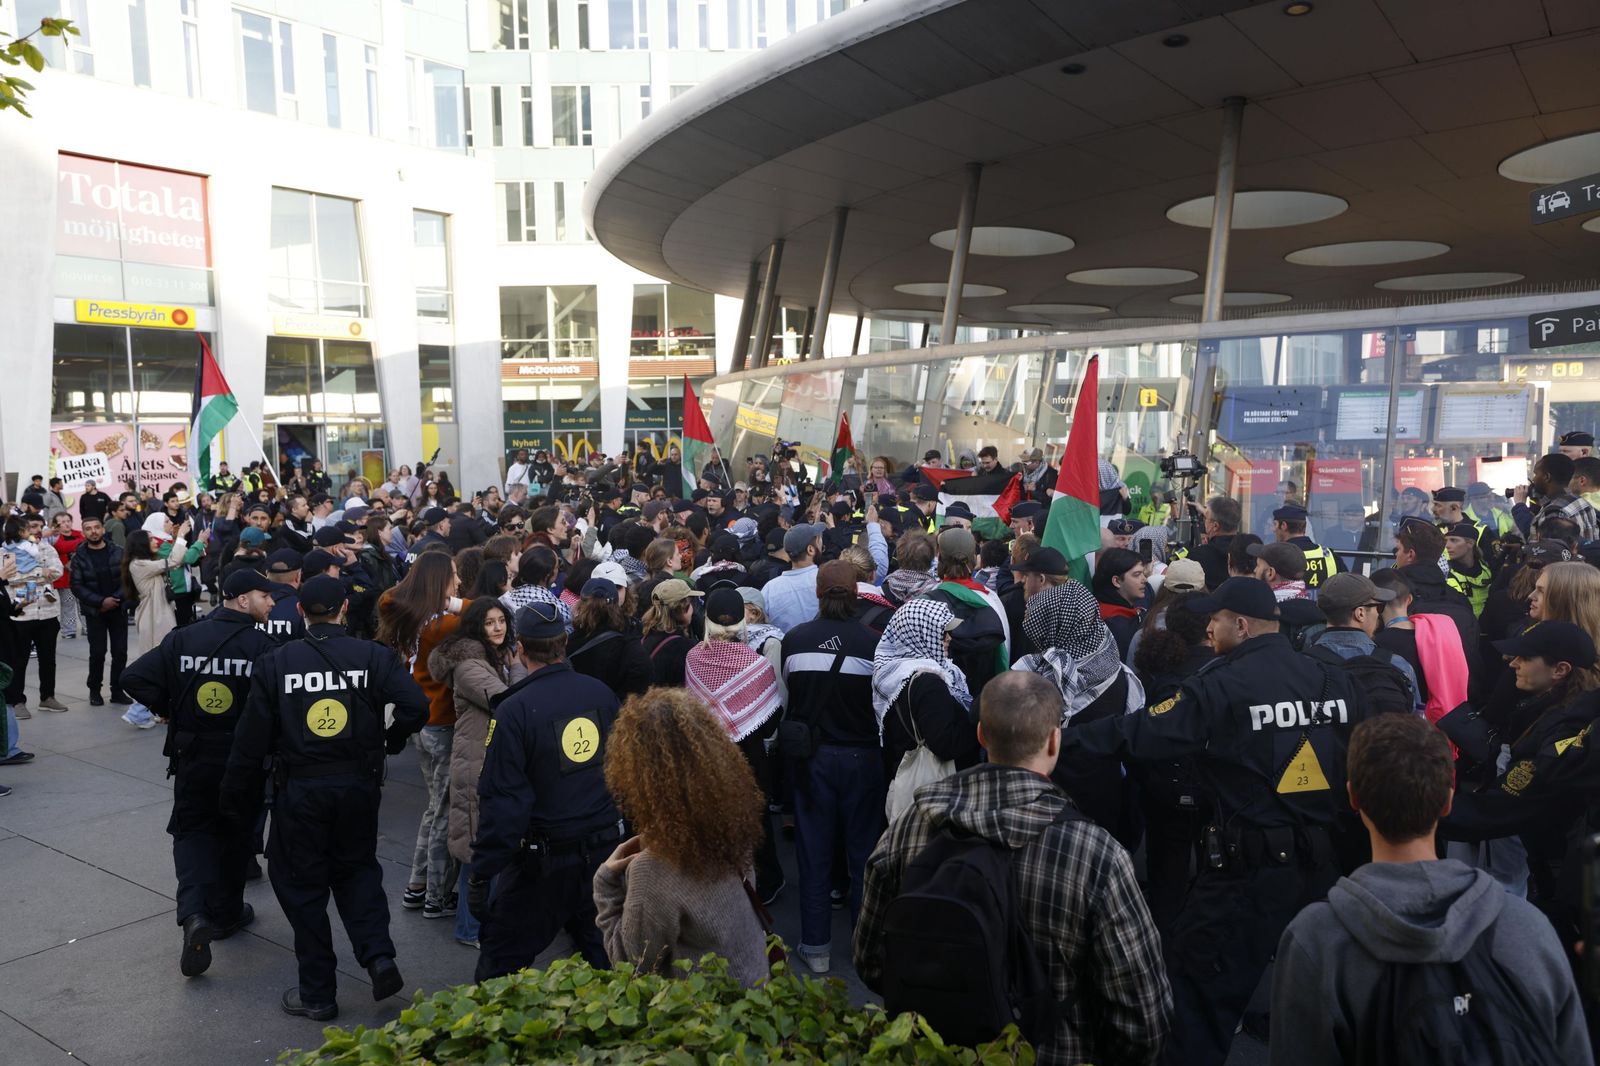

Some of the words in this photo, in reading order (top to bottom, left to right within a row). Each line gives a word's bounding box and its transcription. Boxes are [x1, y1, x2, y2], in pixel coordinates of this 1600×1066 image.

[59, 171, 204, 222] Totala
[64, 219, 206, 250] möjligheter
[89, 303, 166, 323] Pressbyrån
[518, 366, 581, 375] McDonald's
[512, 440, 540, 448] Nyhet!
[63, 457, 101, 471] Halva
[63, 466, 106, 484] priset!
[117, 471, 178, 483] glasigaste
[1309, 573, 1319, 587] 4
[211, 688, 217, 698] 1
[206, 698, 223, 708] 22
[324, 706, 330, 716] 1
[317, 718, 336, 730] 22
[576, 726, 583, 738] 1
[574, 740, 590, 755] 22
[1300, 762, 1306, 771] 1
[1297, 776, 1309, 786] 23
